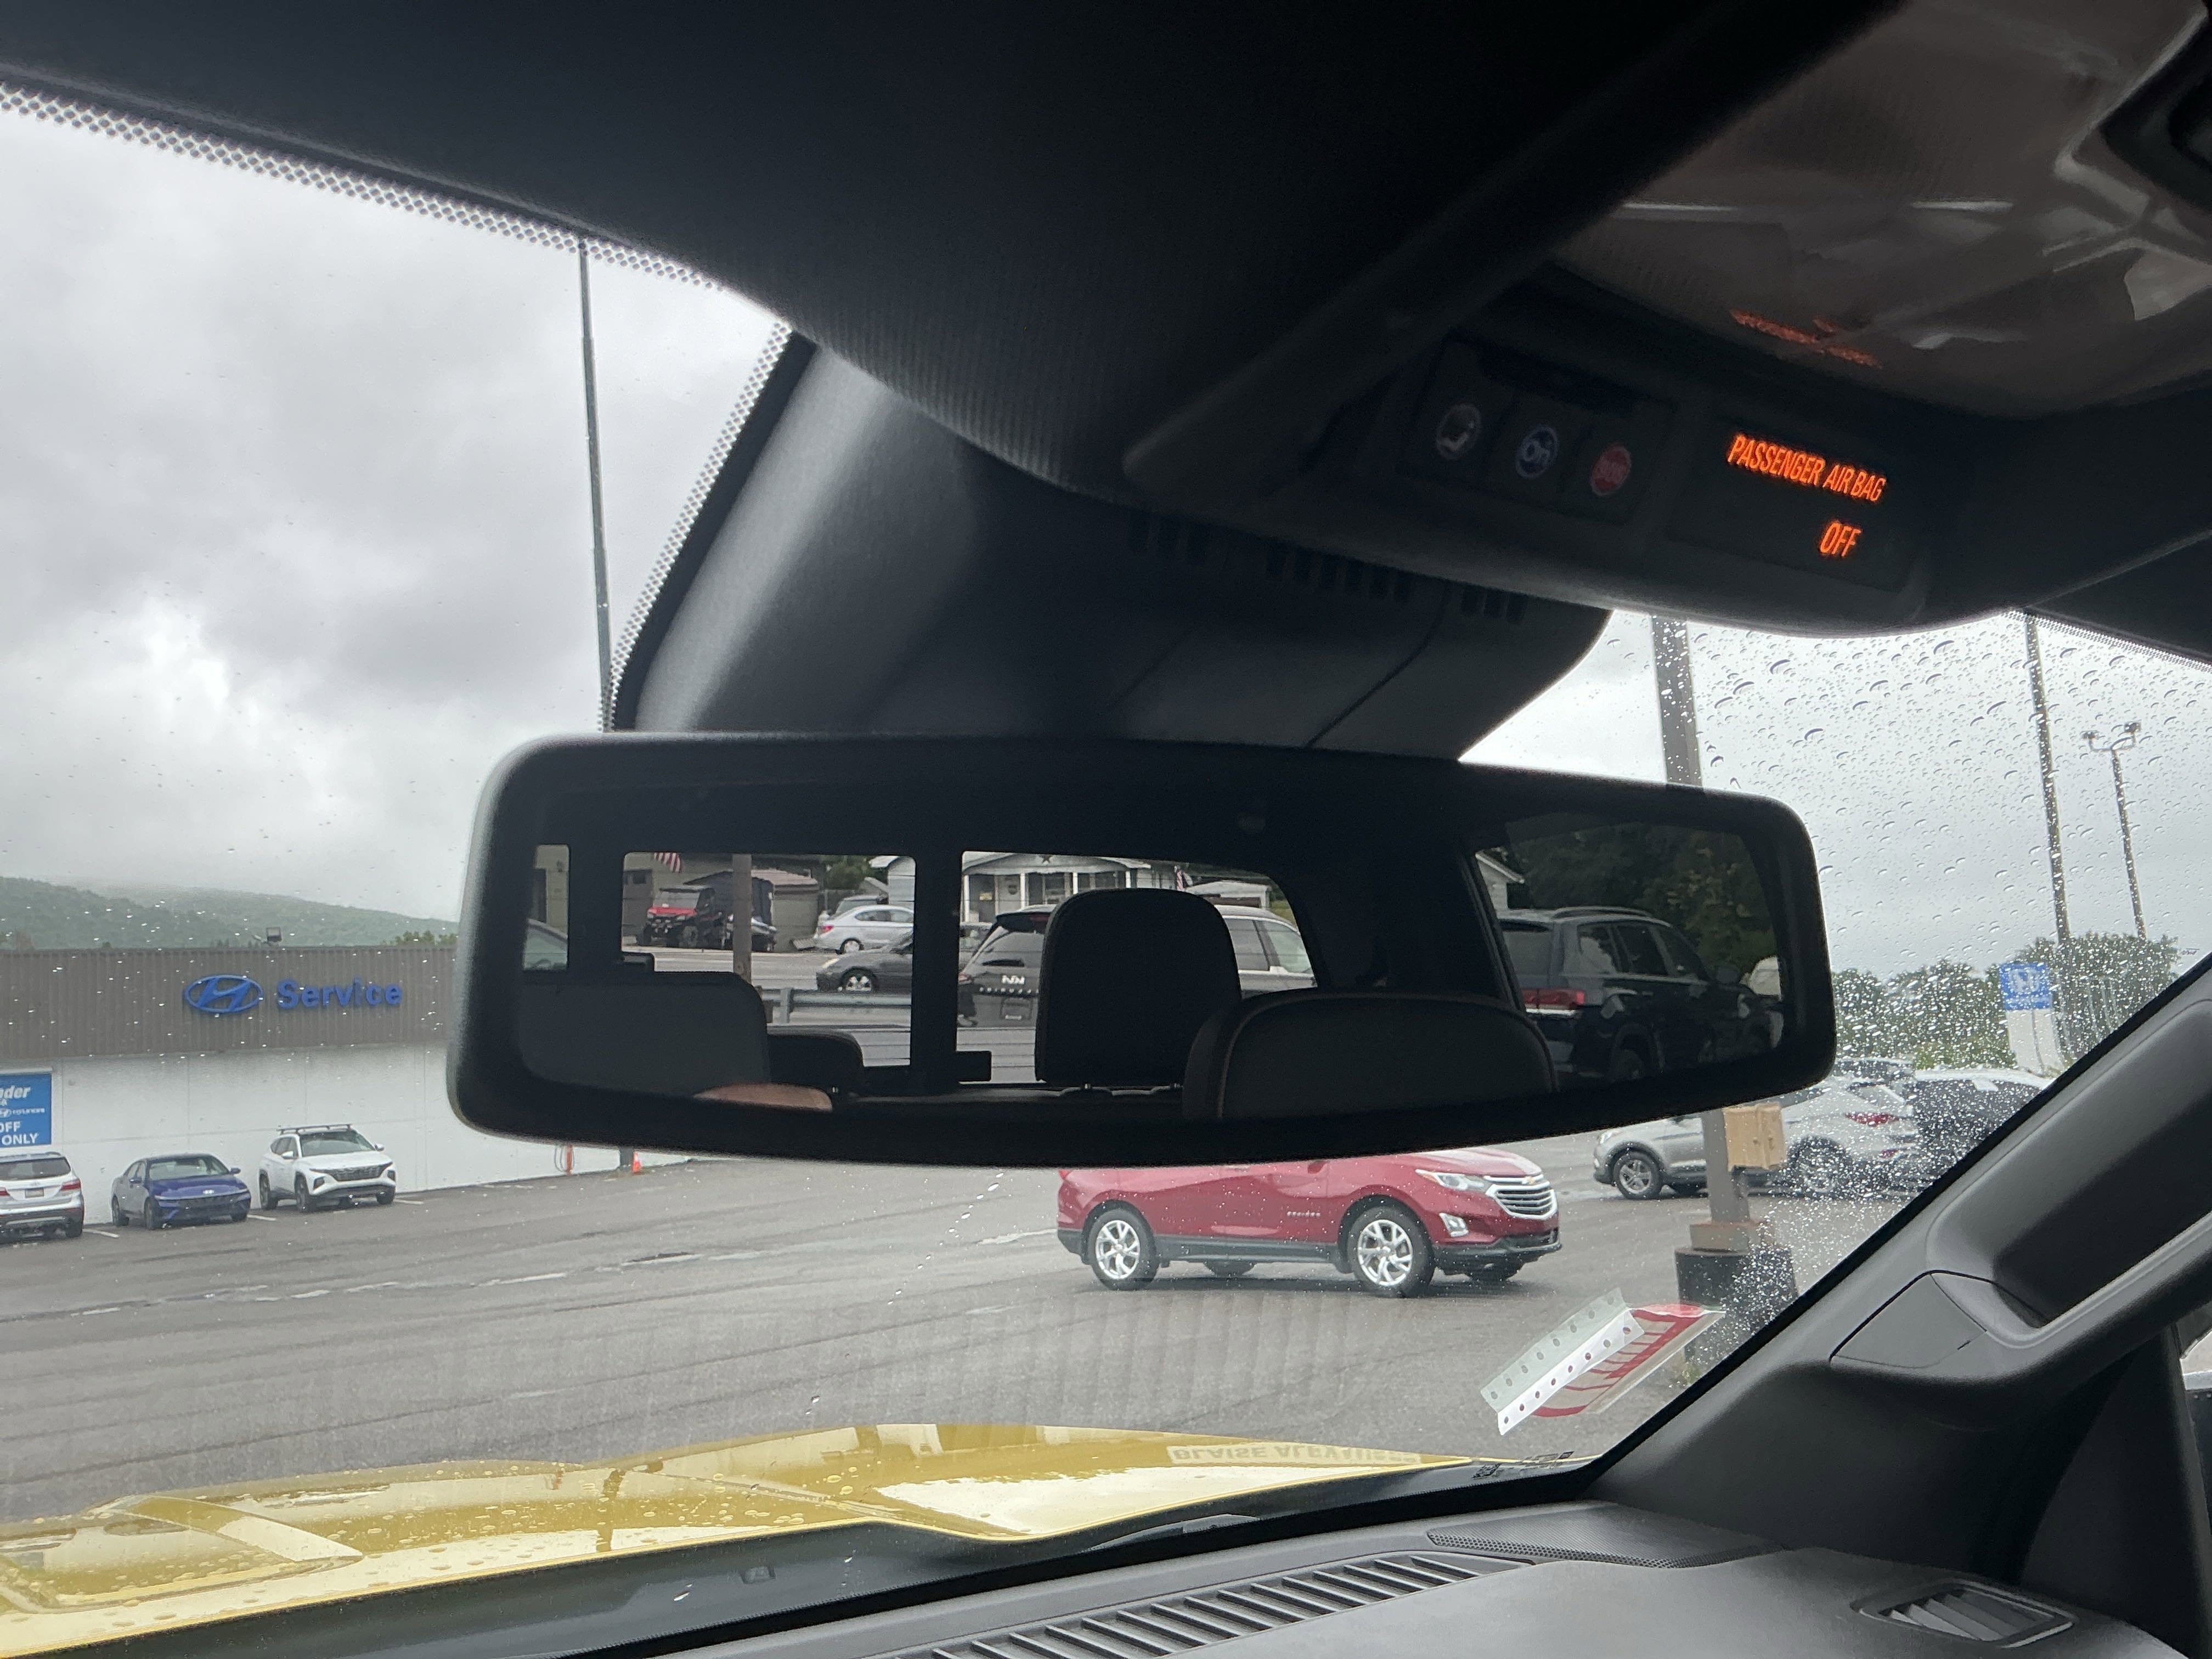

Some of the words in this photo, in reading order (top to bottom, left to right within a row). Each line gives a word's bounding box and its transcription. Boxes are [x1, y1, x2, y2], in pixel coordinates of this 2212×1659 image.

[1728, 435, 1826, 486] PASSENGER
[1820, 522, 1861, 557] OFF
[278, 978, 402, 1009] Service
[2, 1133, 38, 1146] ONLY
